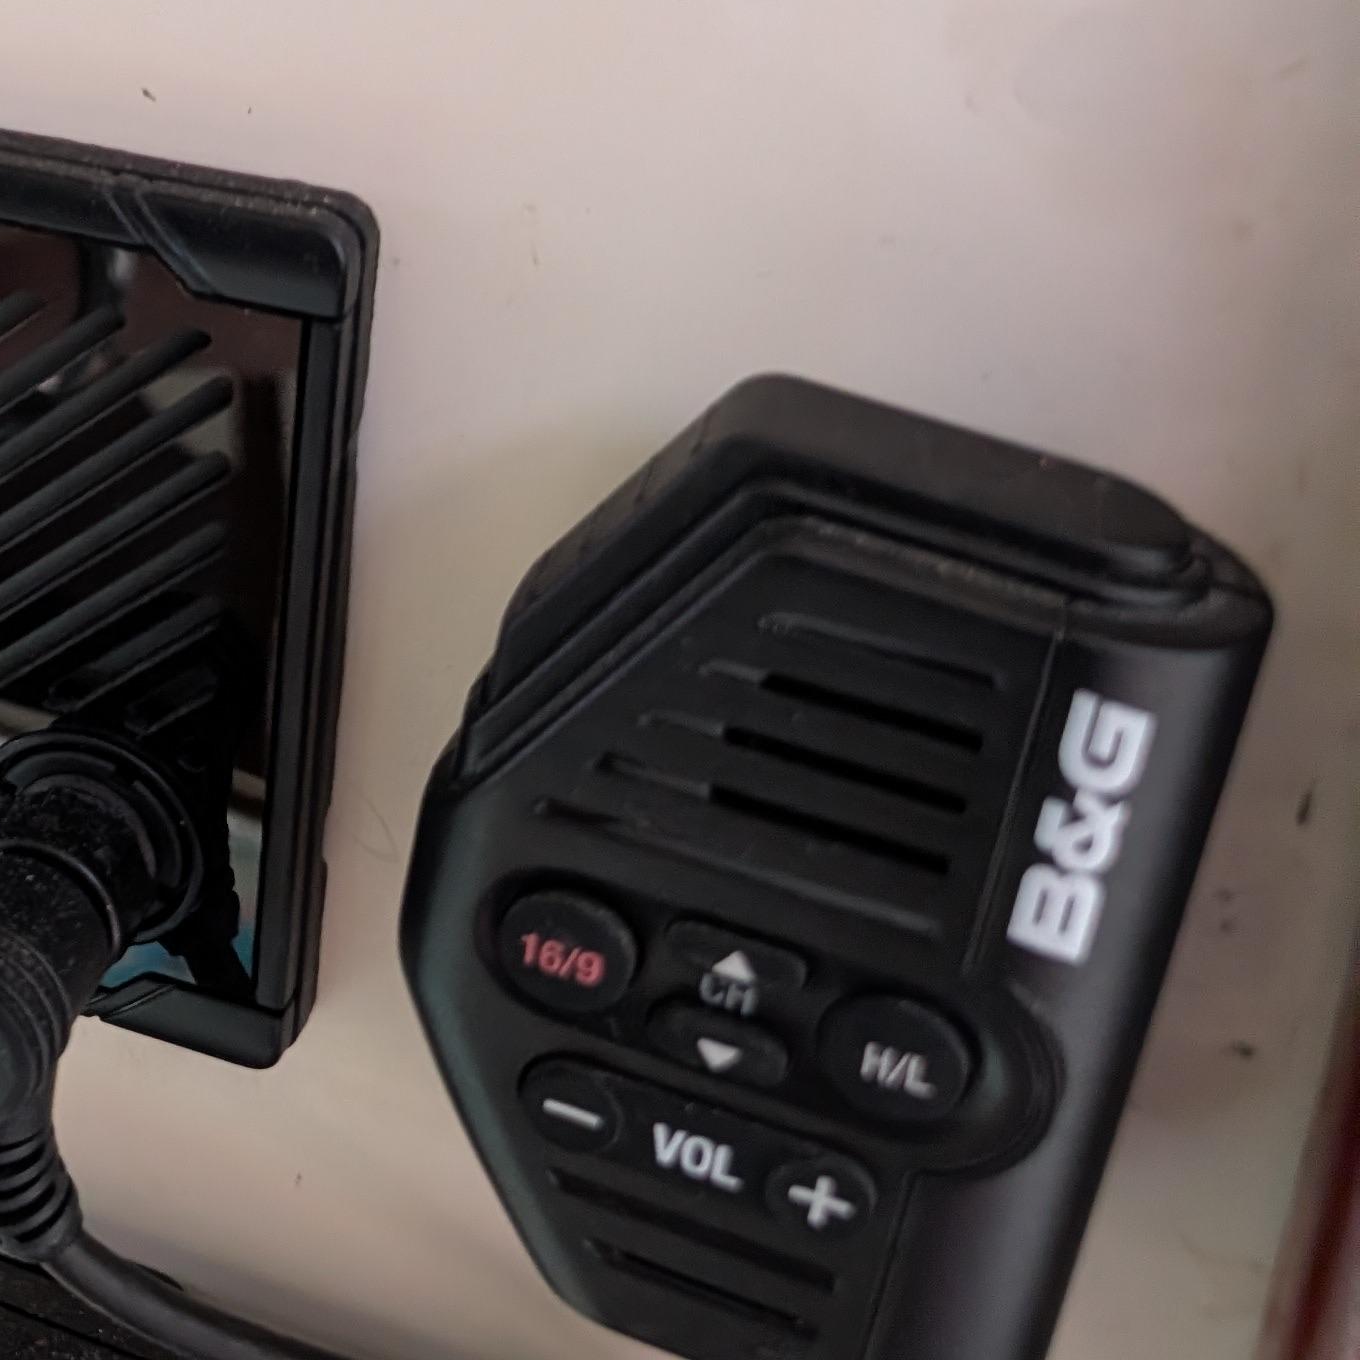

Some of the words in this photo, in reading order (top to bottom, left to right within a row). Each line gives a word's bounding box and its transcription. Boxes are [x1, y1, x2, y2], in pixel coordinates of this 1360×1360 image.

[1005, 686, 1158, 966] B&G
[519, 930, 607, 987] 16/9
[859, 1042, 938, 1100] H/L
[652, 1120, 744, 1191] VOL
